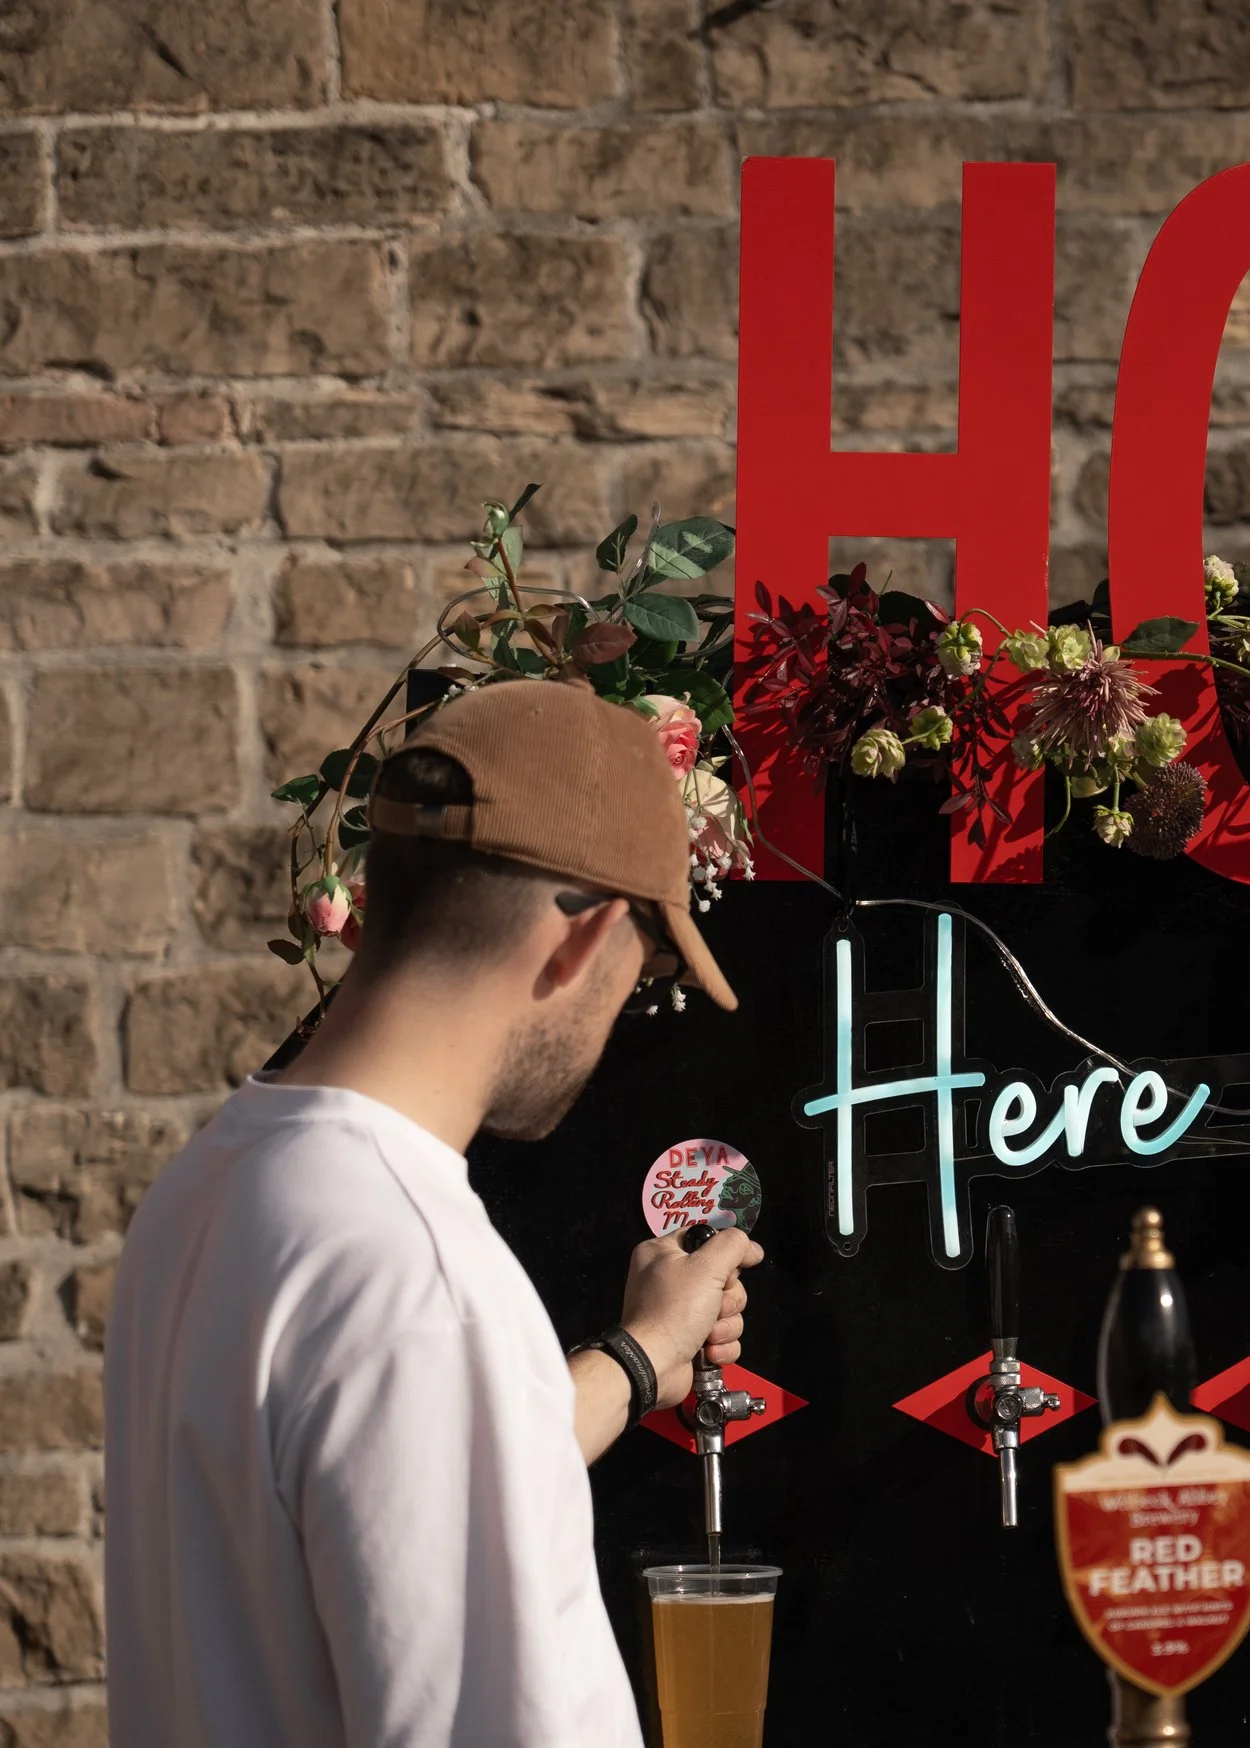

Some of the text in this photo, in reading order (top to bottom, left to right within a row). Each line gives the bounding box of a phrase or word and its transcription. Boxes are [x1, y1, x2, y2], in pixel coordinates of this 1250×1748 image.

[803, 912, 1211, 1258] Here
[668, 1145, 729, 1169] DEYA
[654, 1170, 719, 1197] Steady
[651, 1190, 716, 1214] Rolling
[1130, 1534, 1202, 1565] RED
[1089, 1559, 1245, 1597] FEATHER
